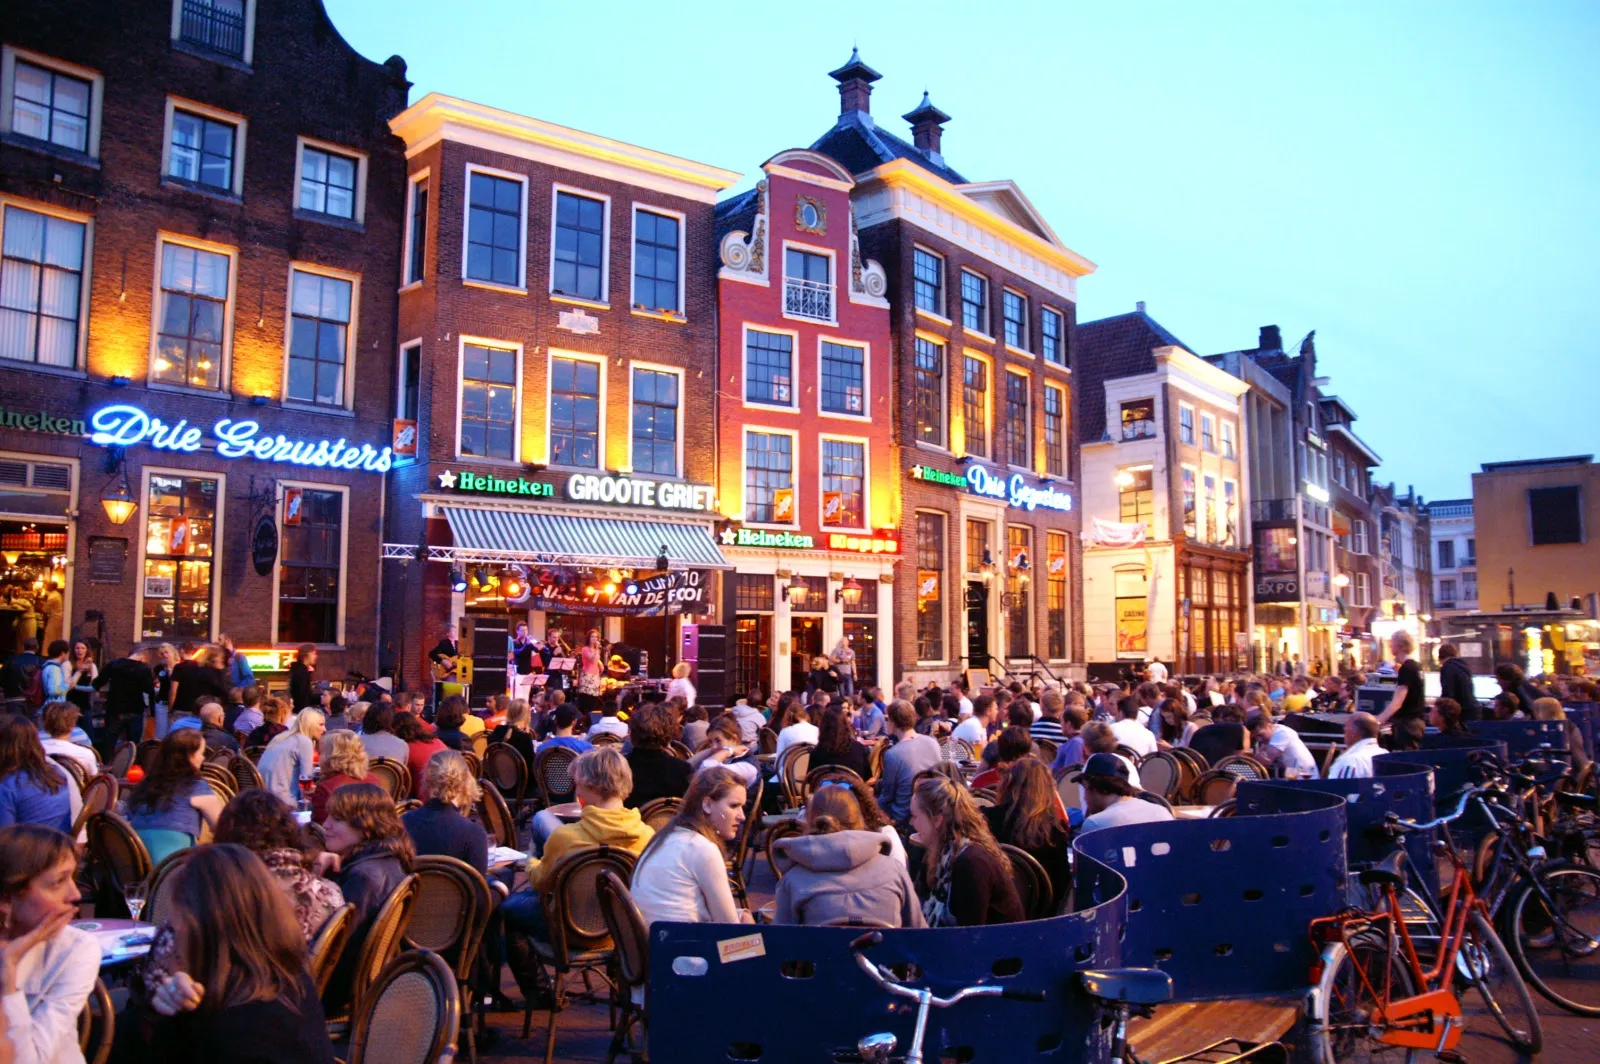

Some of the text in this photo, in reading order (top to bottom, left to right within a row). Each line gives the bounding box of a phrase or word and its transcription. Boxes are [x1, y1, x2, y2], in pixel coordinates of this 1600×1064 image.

[91, 404, 202, 452] Drie
[214, 418, 393, 472] Gezusters
[459, 472, 554, 497] Heineken
[923, 465, 967, 487] Heineken
[568, 473, 716, 511] GROOTE GRIET
[737, 528, 814, 549] Heineken
[608, 592, 642, 606] VAN
[644, 590, 665, 605] DE
[668, 587, 702, 602] FOOI
[1257, 582, 1297, 594] EXPO
